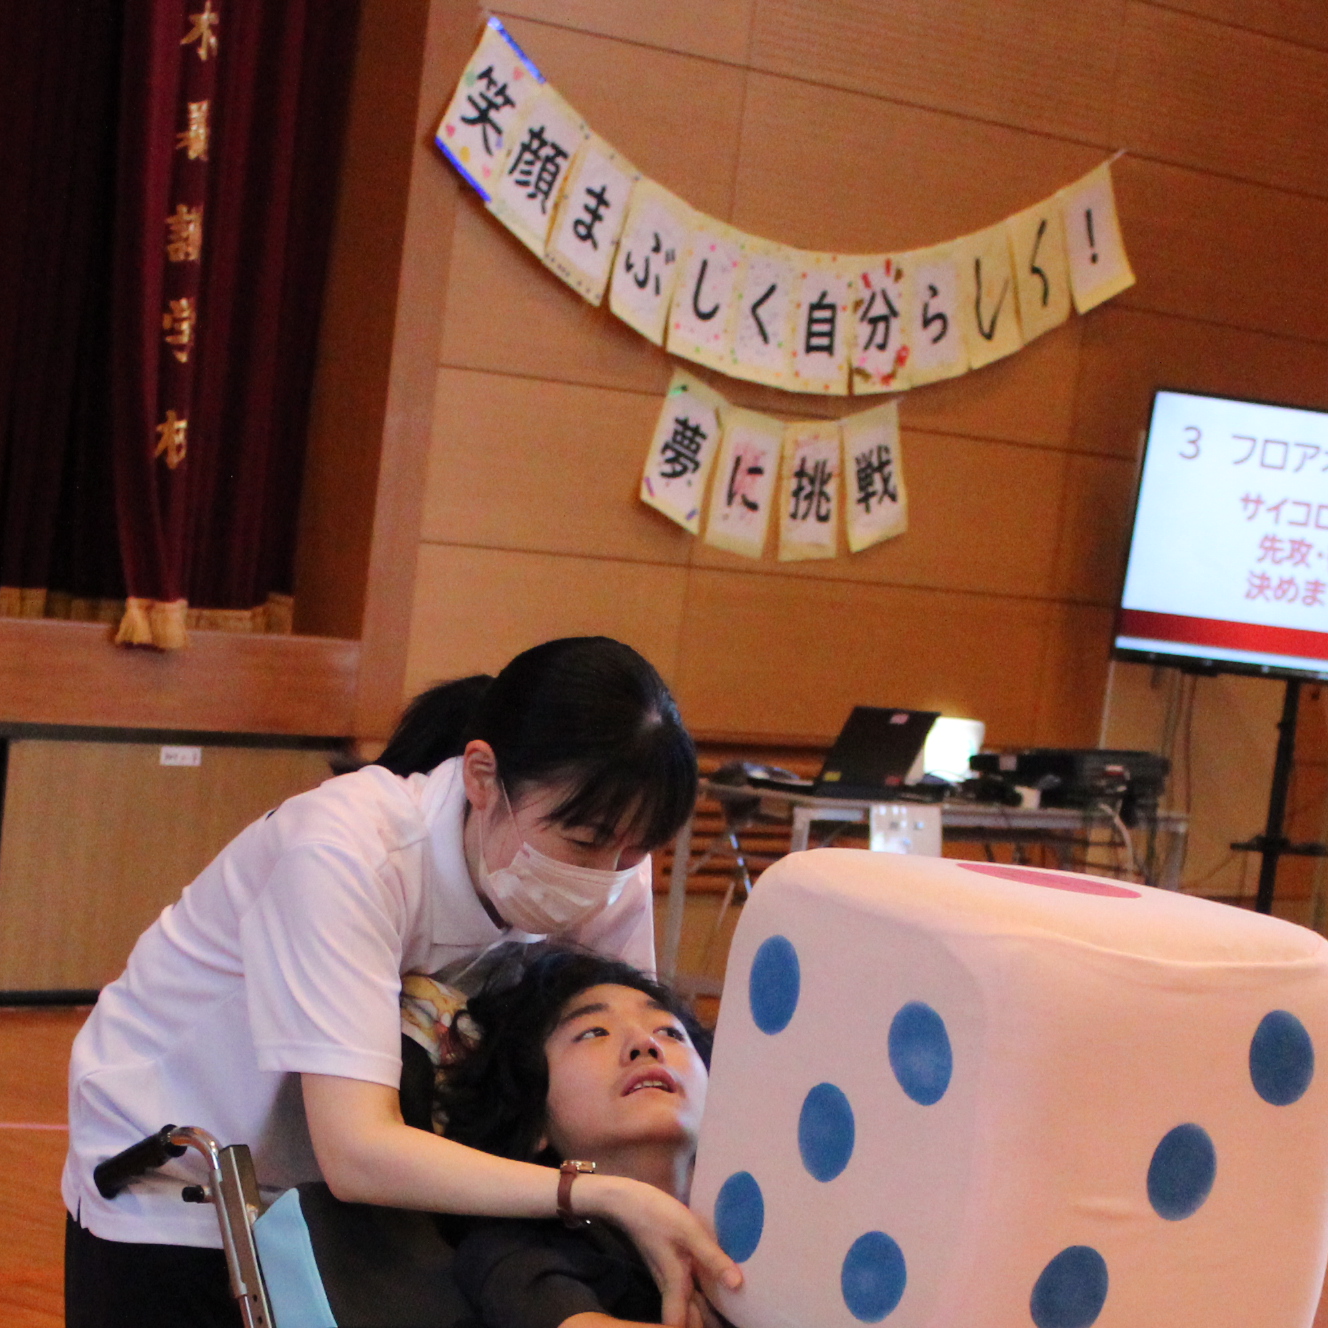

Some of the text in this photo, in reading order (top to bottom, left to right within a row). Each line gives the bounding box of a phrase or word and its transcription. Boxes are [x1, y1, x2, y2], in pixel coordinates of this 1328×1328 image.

[459, 65, 1099, 357] 笑顔まぶしく自分らしく！
[659, 416, 900, 525] 夢に挑戦
[1178, 425, 1202, 460] 3
